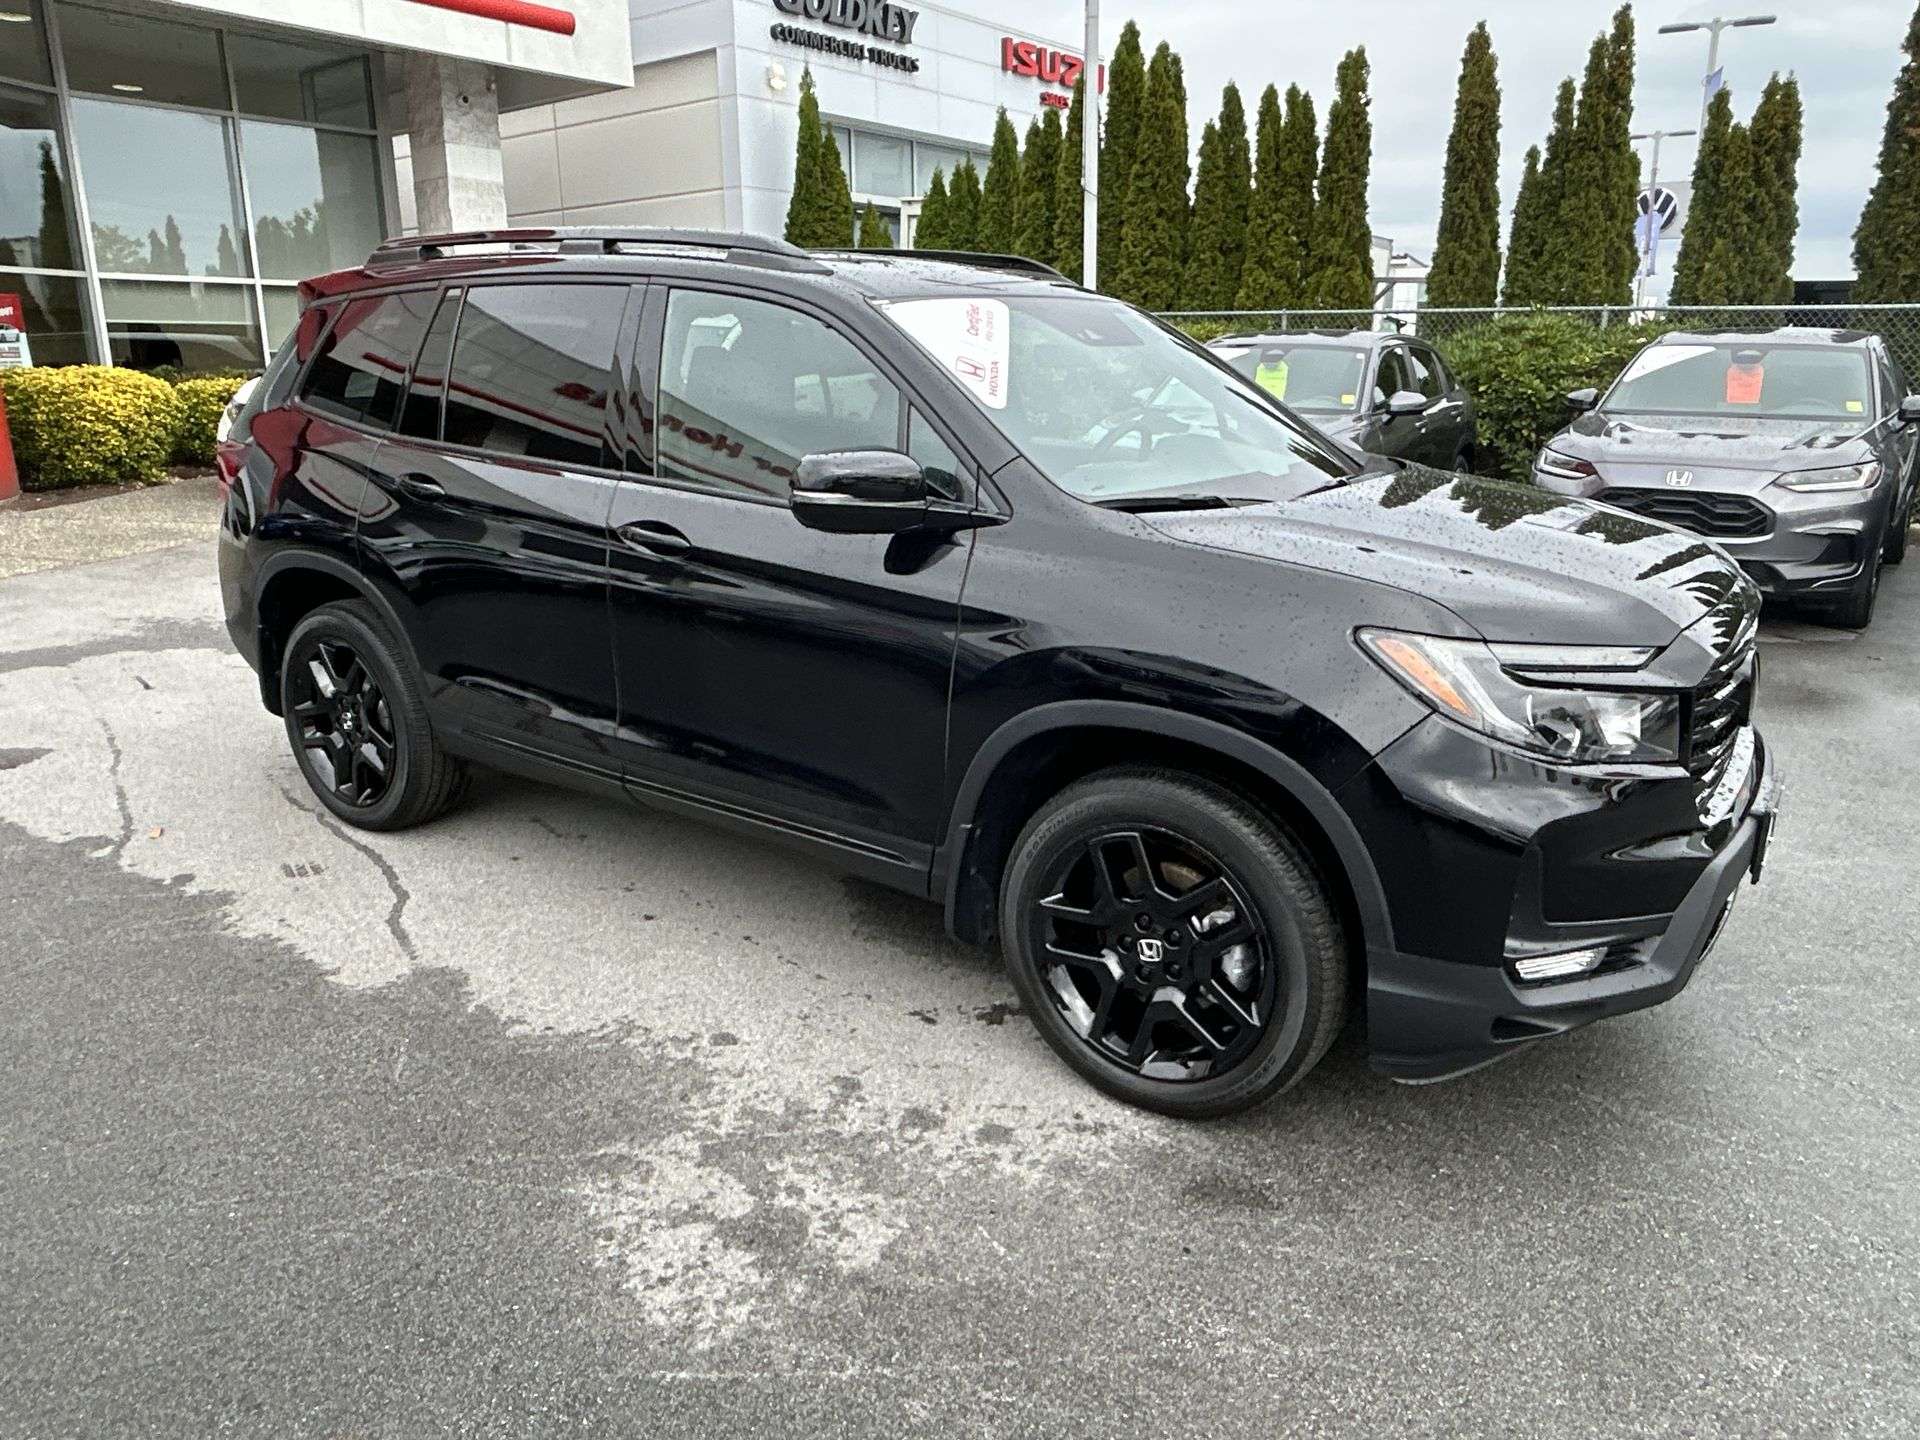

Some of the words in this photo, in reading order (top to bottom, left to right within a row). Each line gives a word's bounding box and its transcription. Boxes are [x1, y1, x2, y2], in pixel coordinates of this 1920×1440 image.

[770, 22, 868, 60] COMMERCIAL
[866, 47, 919, 73] TRUCKS
[988, 360, 1000, 397] HONDA
